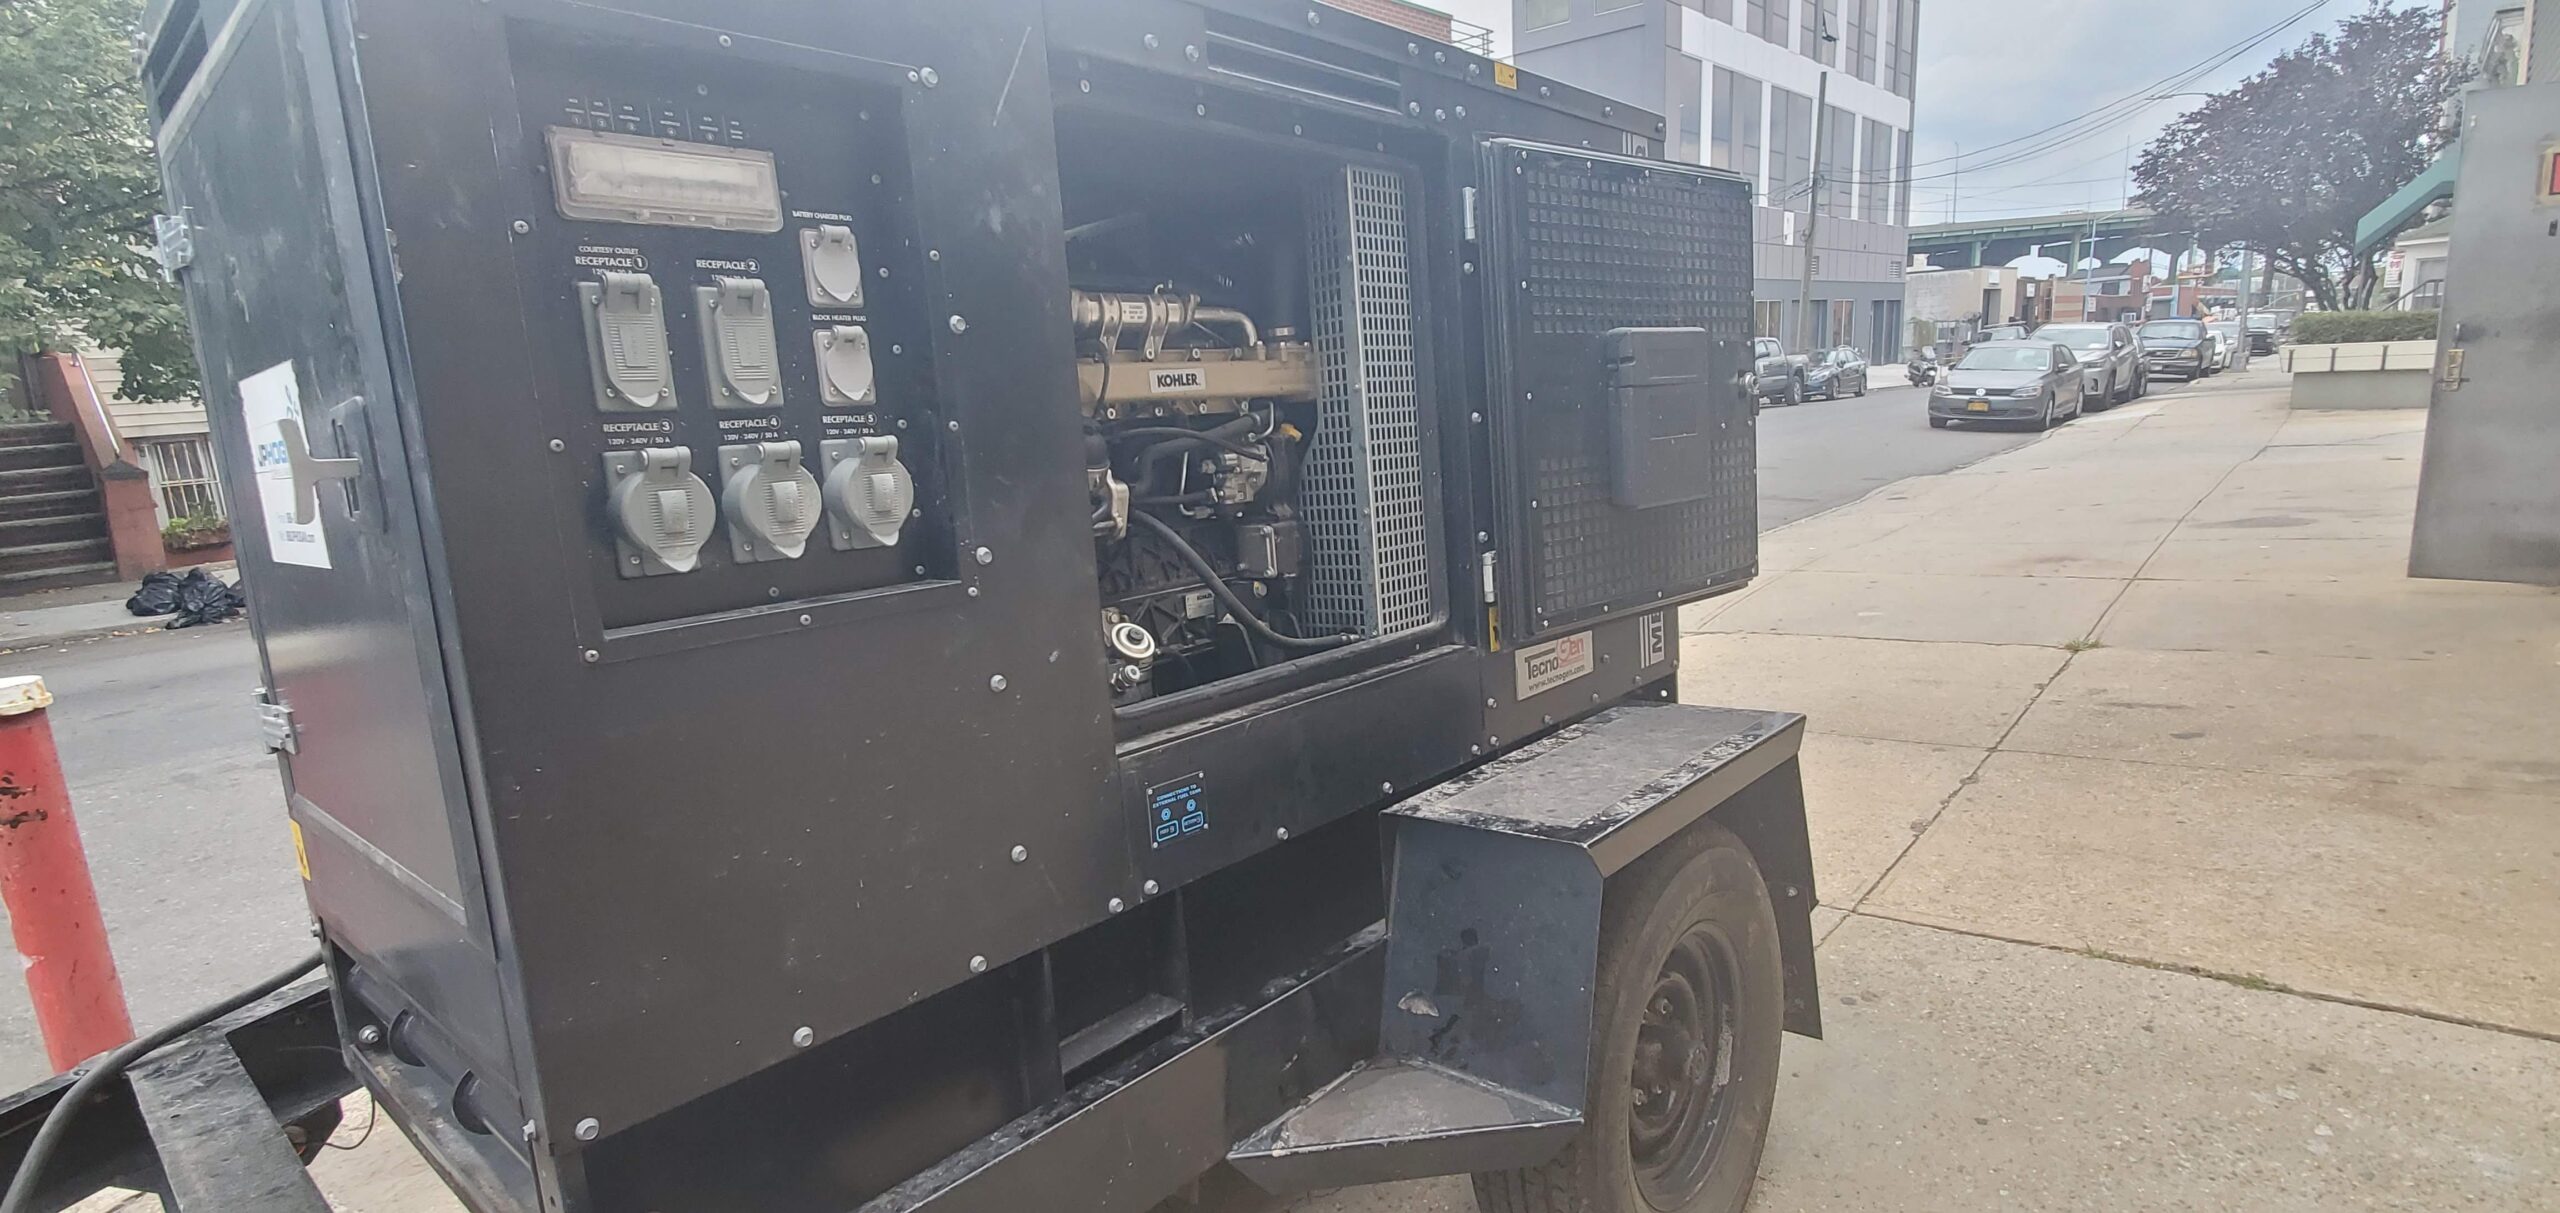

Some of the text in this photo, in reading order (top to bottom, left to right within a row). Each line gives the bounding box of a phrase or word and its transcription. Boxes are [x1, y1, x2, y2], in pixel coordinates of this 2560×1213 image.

[578, 246, 639, 255] COURTESY OUTLET
[575, 256, 633, 267] RECEPTACLE
[696, 259, 747, 270] RECEPTACLE
[1157, 373, 1200, 388] KOHLER
[719, 419, 768, 429] RECEPTACLE
[822, 414, 866, 424] RECEPTACLE
[603, 422, 660, 433] RECEPTACLE
